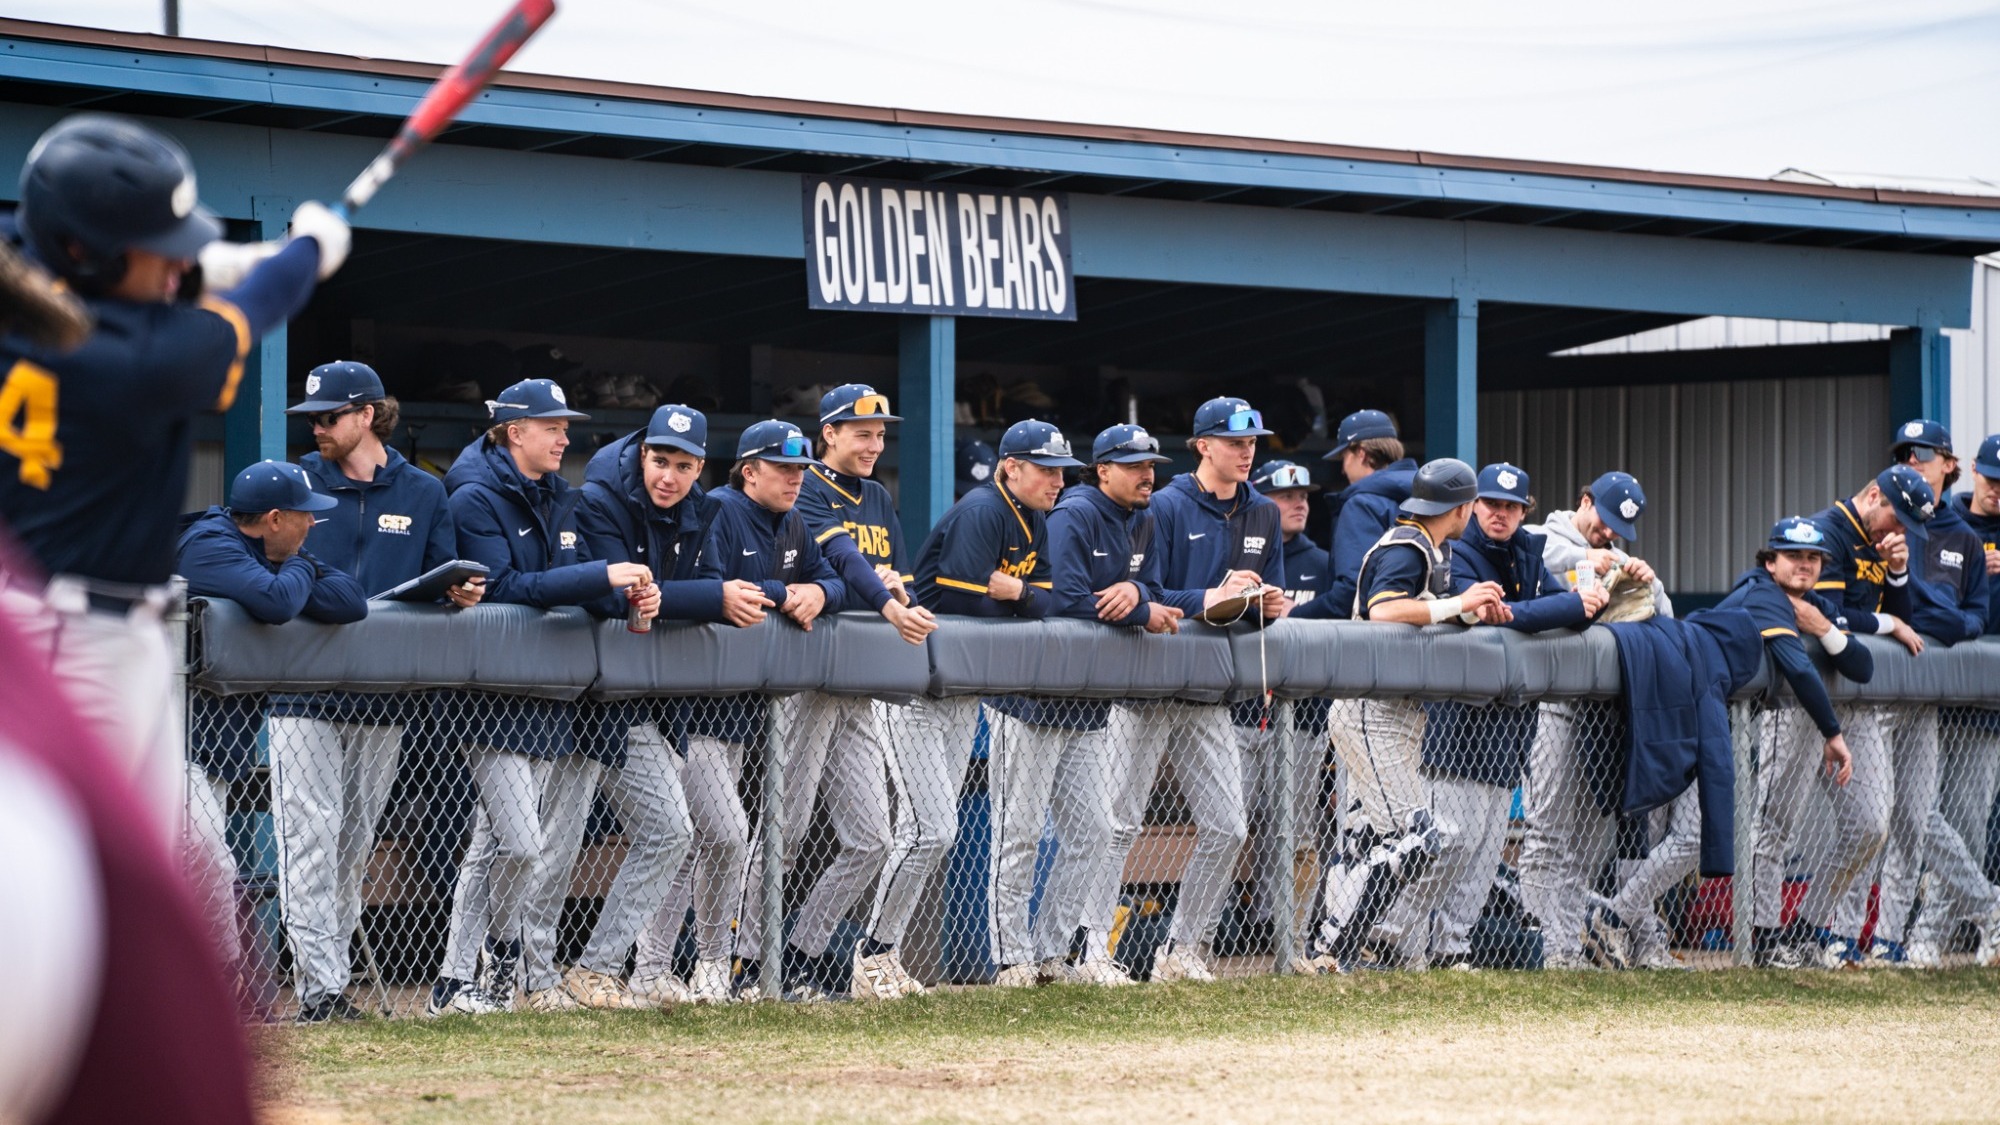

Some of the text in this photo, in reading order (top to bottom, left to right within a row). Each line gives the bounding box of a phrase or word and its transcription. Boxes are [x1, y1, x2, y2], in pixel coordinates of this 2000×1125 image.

[814, 181, 1067, 315] GOLDEN BEARS
[0, 359, 63, 491] 4
[377, 527, 411, 536] BASEBALL
